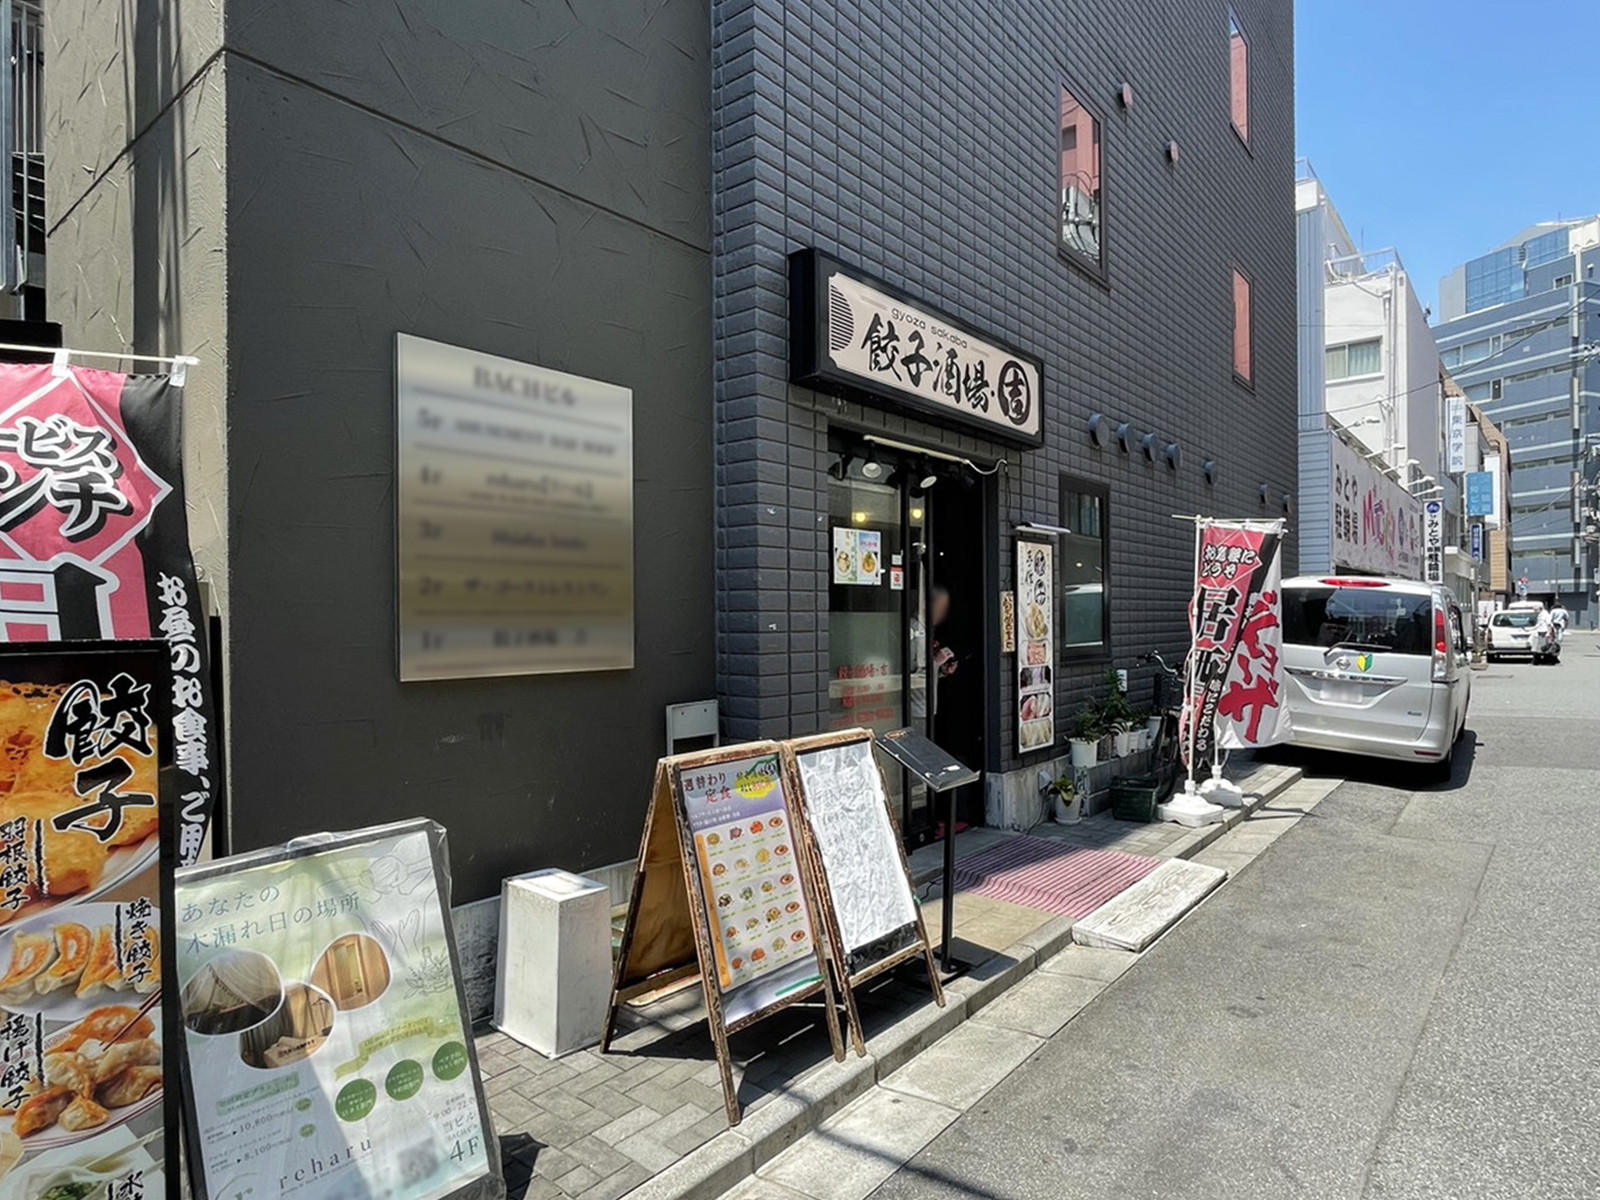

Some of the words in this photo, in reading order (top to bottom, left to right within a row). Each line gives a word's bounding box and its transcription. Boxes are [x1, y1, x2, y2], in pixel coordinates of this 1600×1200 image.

[891, 306, 926, 331] gyoza
[930, 324, 968, 349] sakaba
[43, 671, 156, 843] 餃子
[181, 884, 281, 923] あなたの
[183, 891, 362, 955] 木漏れ日の場所
[126, 897, 152, 984] 焼き餃子
[0, 1013, 31, 1110] 揚げ餃子
[278, 1138, 373, 1190] reharu
[449, 1135, 480, 1162] 4F
